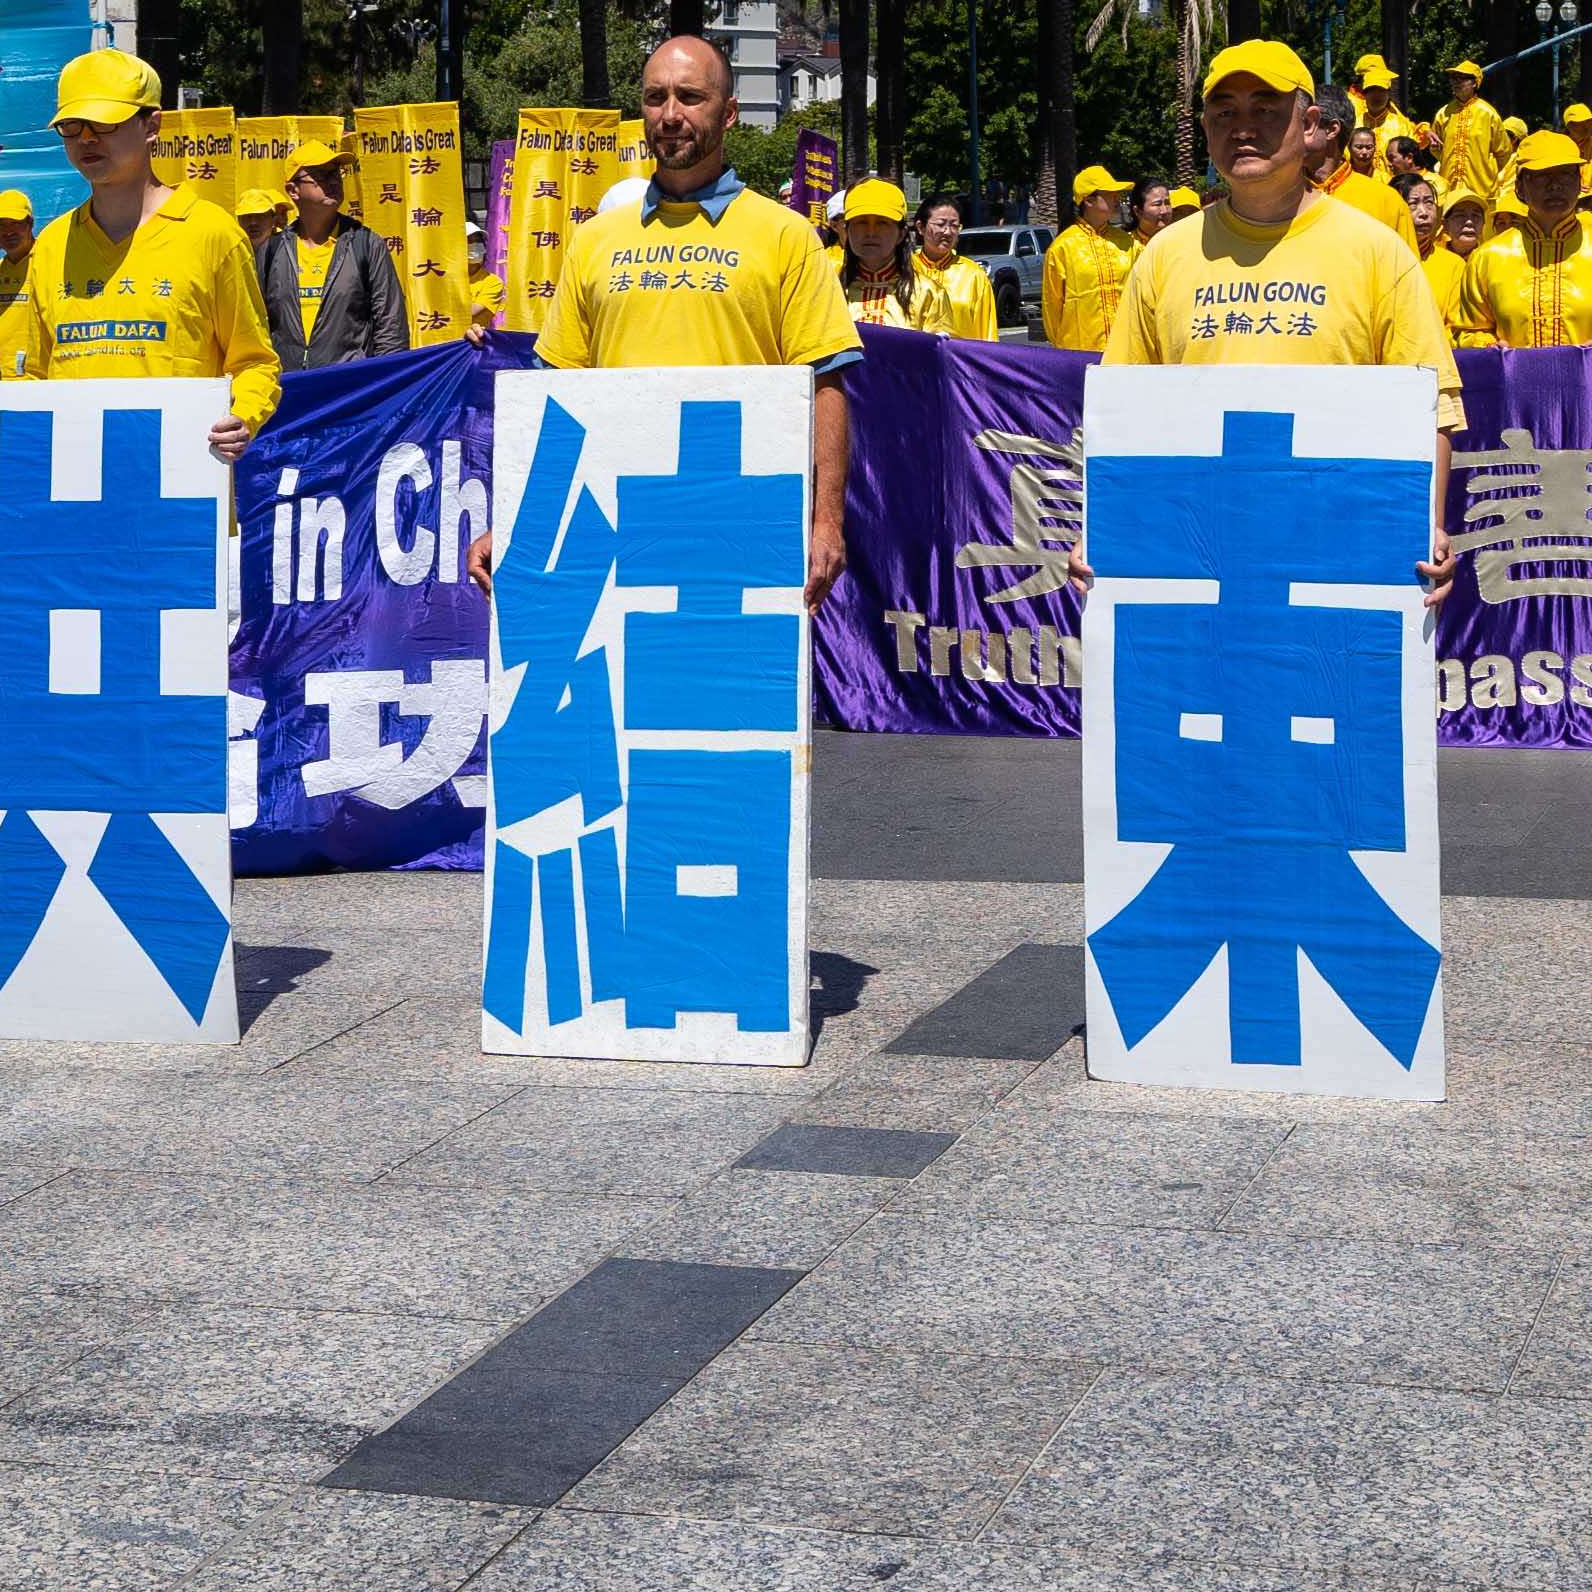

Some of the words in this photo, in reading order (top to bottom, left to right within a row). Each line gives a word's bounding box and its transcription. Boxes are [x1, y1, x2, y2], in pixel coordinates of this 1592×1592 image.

[151, 137, 173, 158] alun
[197, 135, 205, 157] is
[206, 133, 233, 156] Great
[240, 138, 269, 160] Falun
[361, 132, 388, 154] Falun
[414, 129, 424, 152] is
[425, 128, 456, 150] Great
[519, 128, 552, 150] Falun
[575, 130, 585, 152] is
[587, 131, 617, 153] Great
[618, 146, 636, 162] lun
[187, 161, 219, 180] 法
[409, 156, 451, 331] 法輪大法
[528, 181, 562, 299] 是佛法
[611, 245, 675, 268] FALUN
[679, 245, 739, 268] GONG
[57, 276, 173, 300] 法輪大法
[608, 269, 730, 294] 法輪大法
[1195, 281, 1260, 309] FALUN
[1264, 281, 1326, 306] GONG
[61, 322, 108, 340] FALUN
[114, 322, 160, 338] DAFA
[1191, 310, 1318, 340] 法輪大法
[272, 468, 346, 605] in
[884, 610, 1083, 688] Truth
[485, 395, 804, 1037] 結
[1085, 411, 1442, 1071] 束
